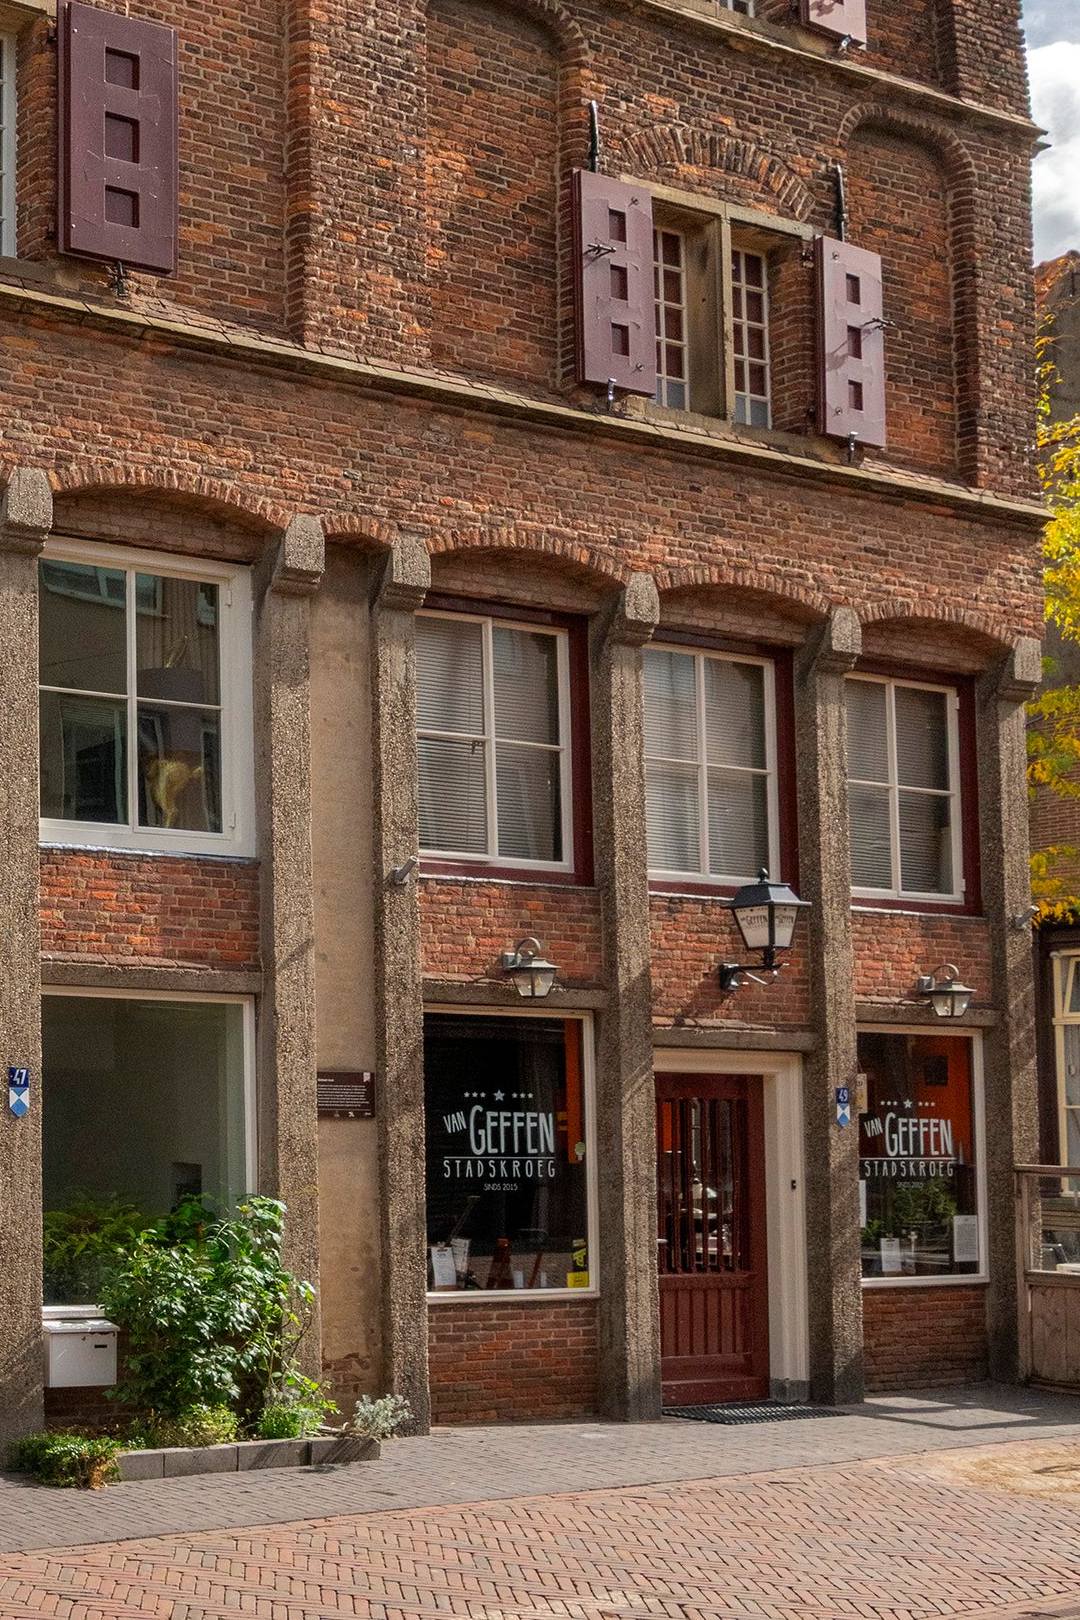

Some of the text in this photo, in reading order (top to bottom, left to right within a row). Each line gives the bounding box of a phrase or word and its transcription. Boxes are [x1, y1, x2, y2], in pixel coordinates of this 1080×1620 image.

[13, 1069, 27, 1085] 47
[838, 1089, 849, 1102] 49
[443, 1105, 555, 1156] VAN GEFFEN
[863, 1111, 954, 1157] VAN GEFFEN
[443, 1160, 556, 1179] STADSKROEG
[863, 1160, 954, 1177] STADSKROEG
[484, 1183, 519, 1191] SINDS 2015
